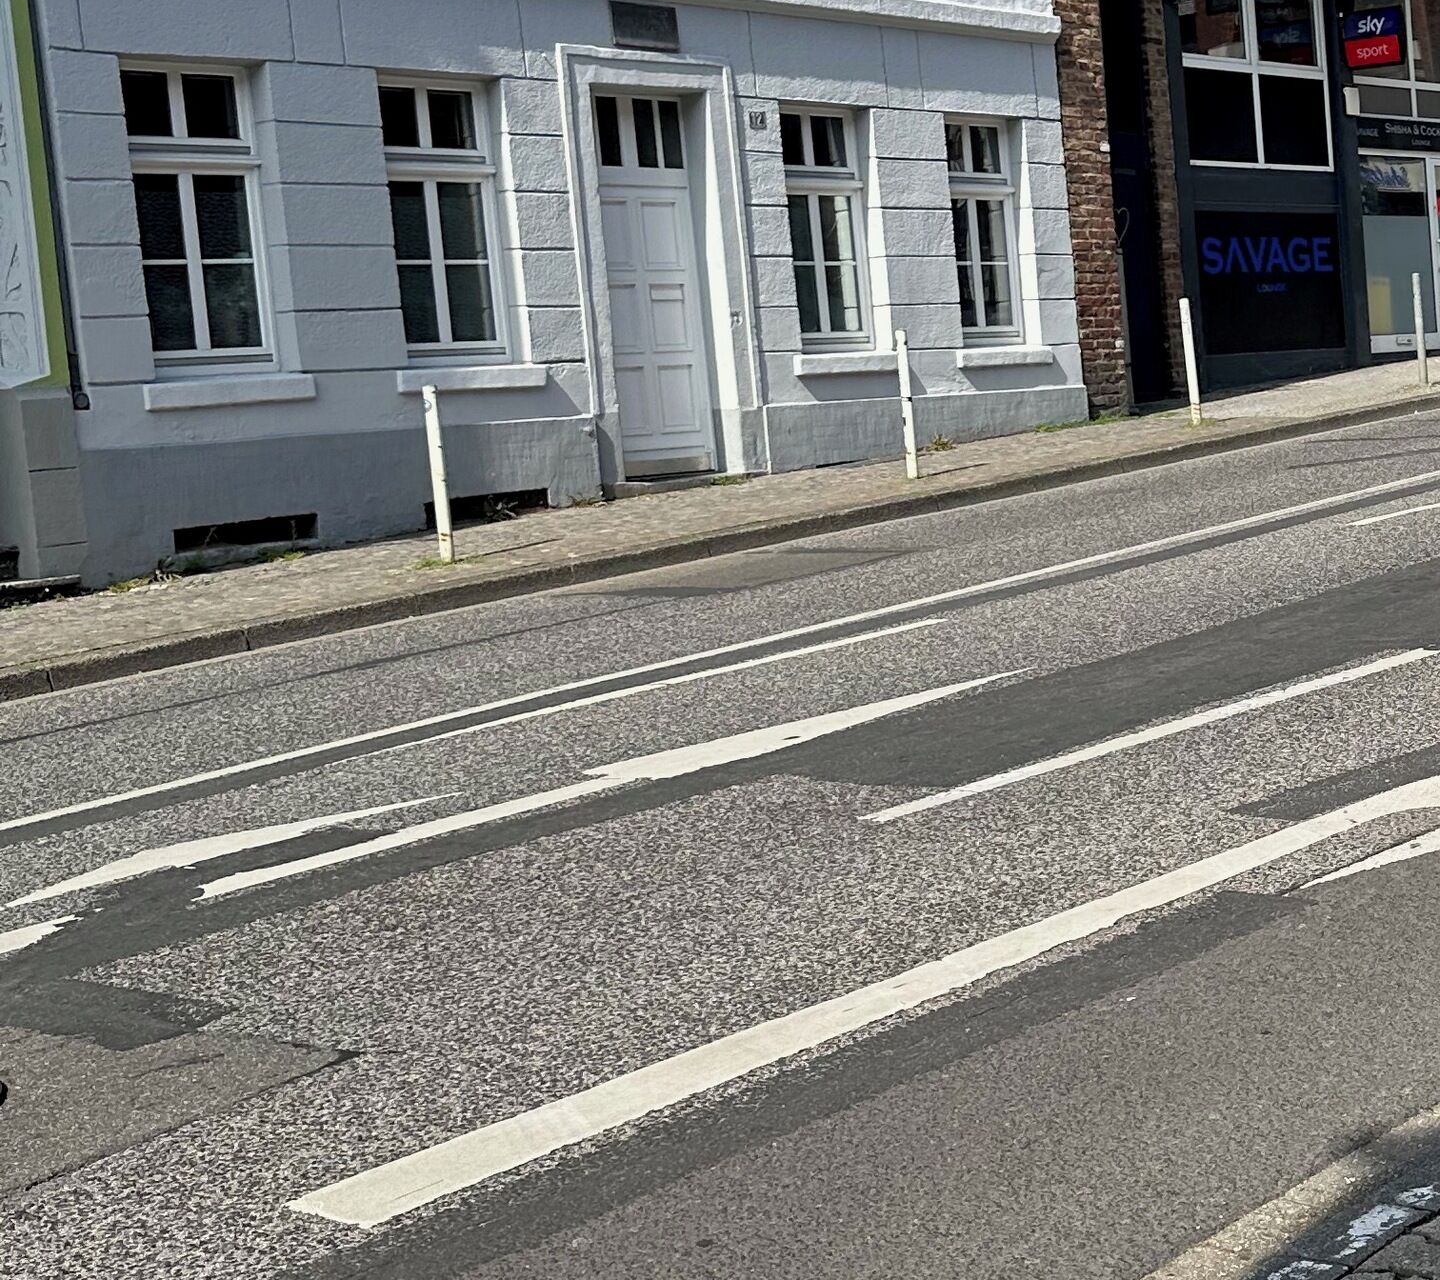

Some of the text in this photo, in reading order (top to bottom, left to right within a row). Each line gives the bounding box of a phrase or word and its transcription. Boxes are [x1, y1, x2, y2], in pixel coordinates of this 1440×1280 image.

[1357, 16, 1385, 35] sky
[1356, 44, 1389, 59] sport
[1413, 124, 1420, 135] &
[1201, 236, 1334, 274] SAVAGE
